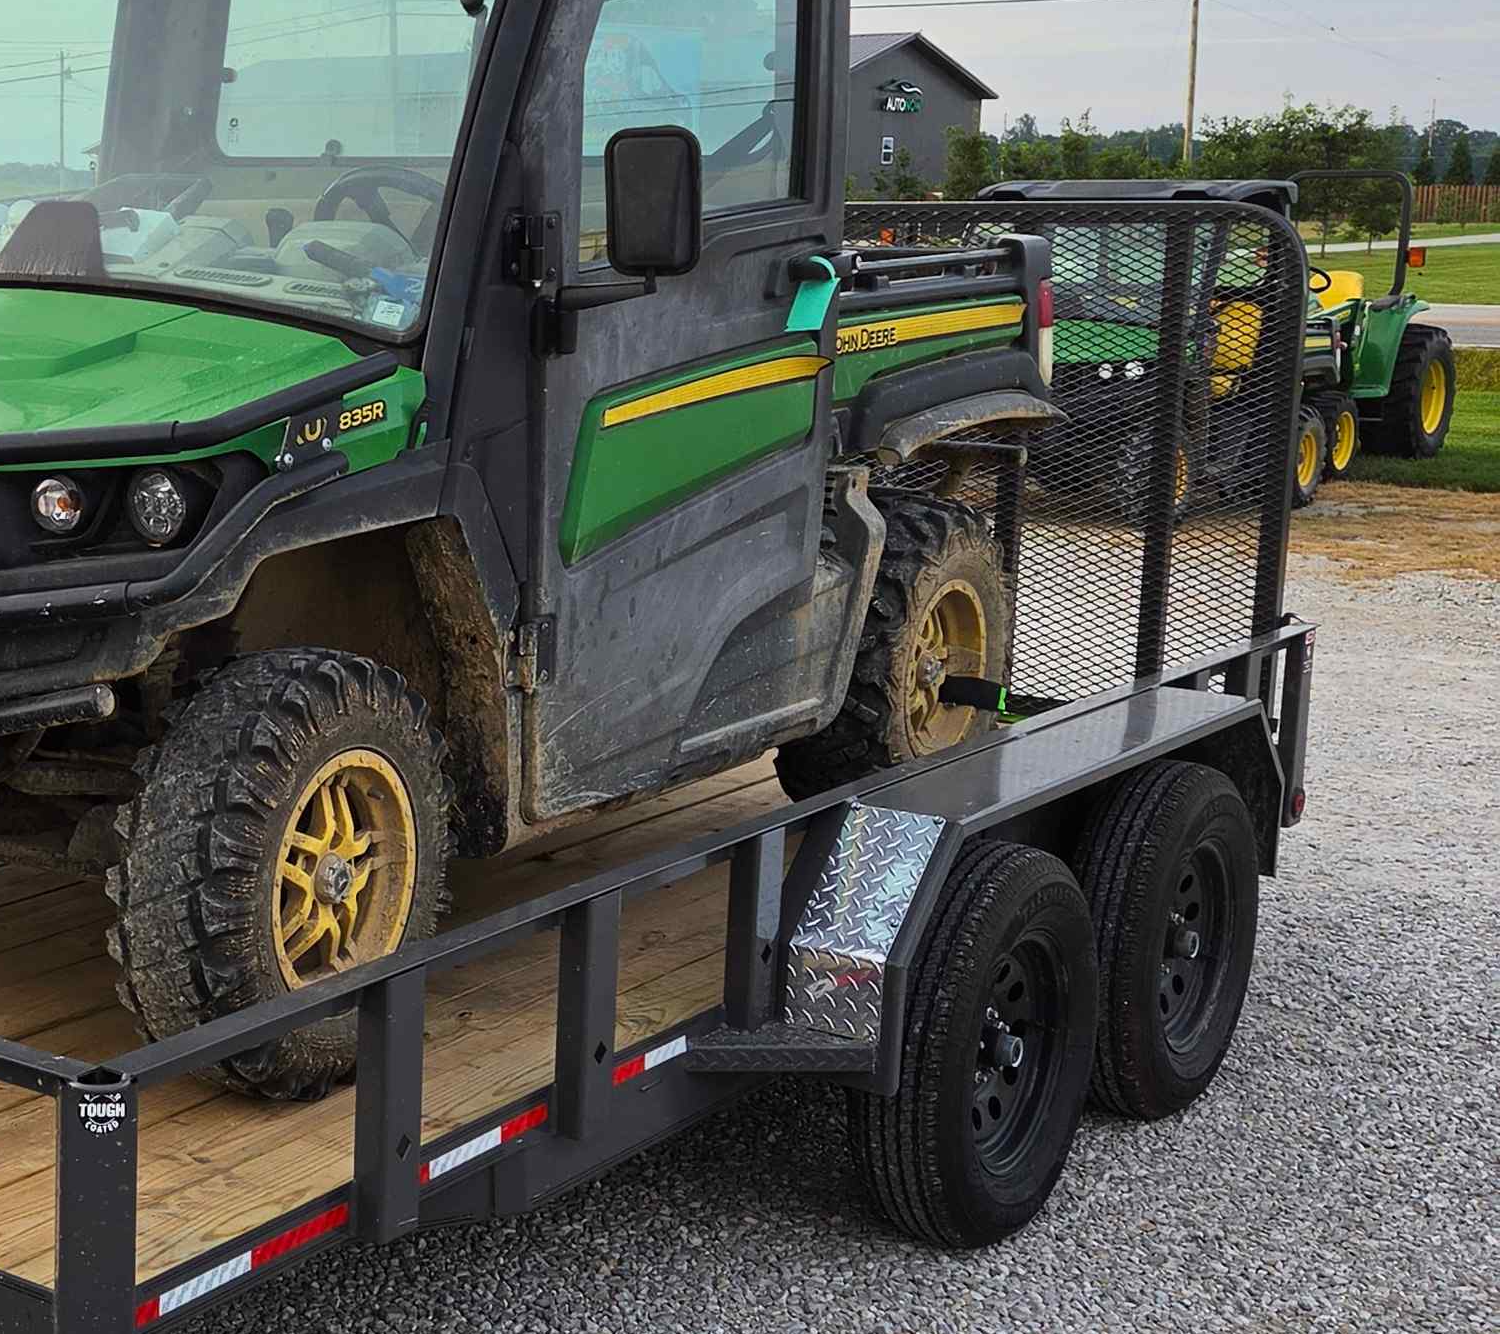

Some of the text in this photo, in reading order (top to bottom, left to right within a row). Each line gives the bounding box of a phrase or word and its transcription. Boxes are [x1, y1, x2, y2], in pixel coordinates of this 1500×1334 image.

[836, 327, 897, 355] OHN DEERE
[338, 400, 385, 431] 835R
[78, 1103, 126, 1118] TOUGH
[84, 1120, 120, 1134] COATED
